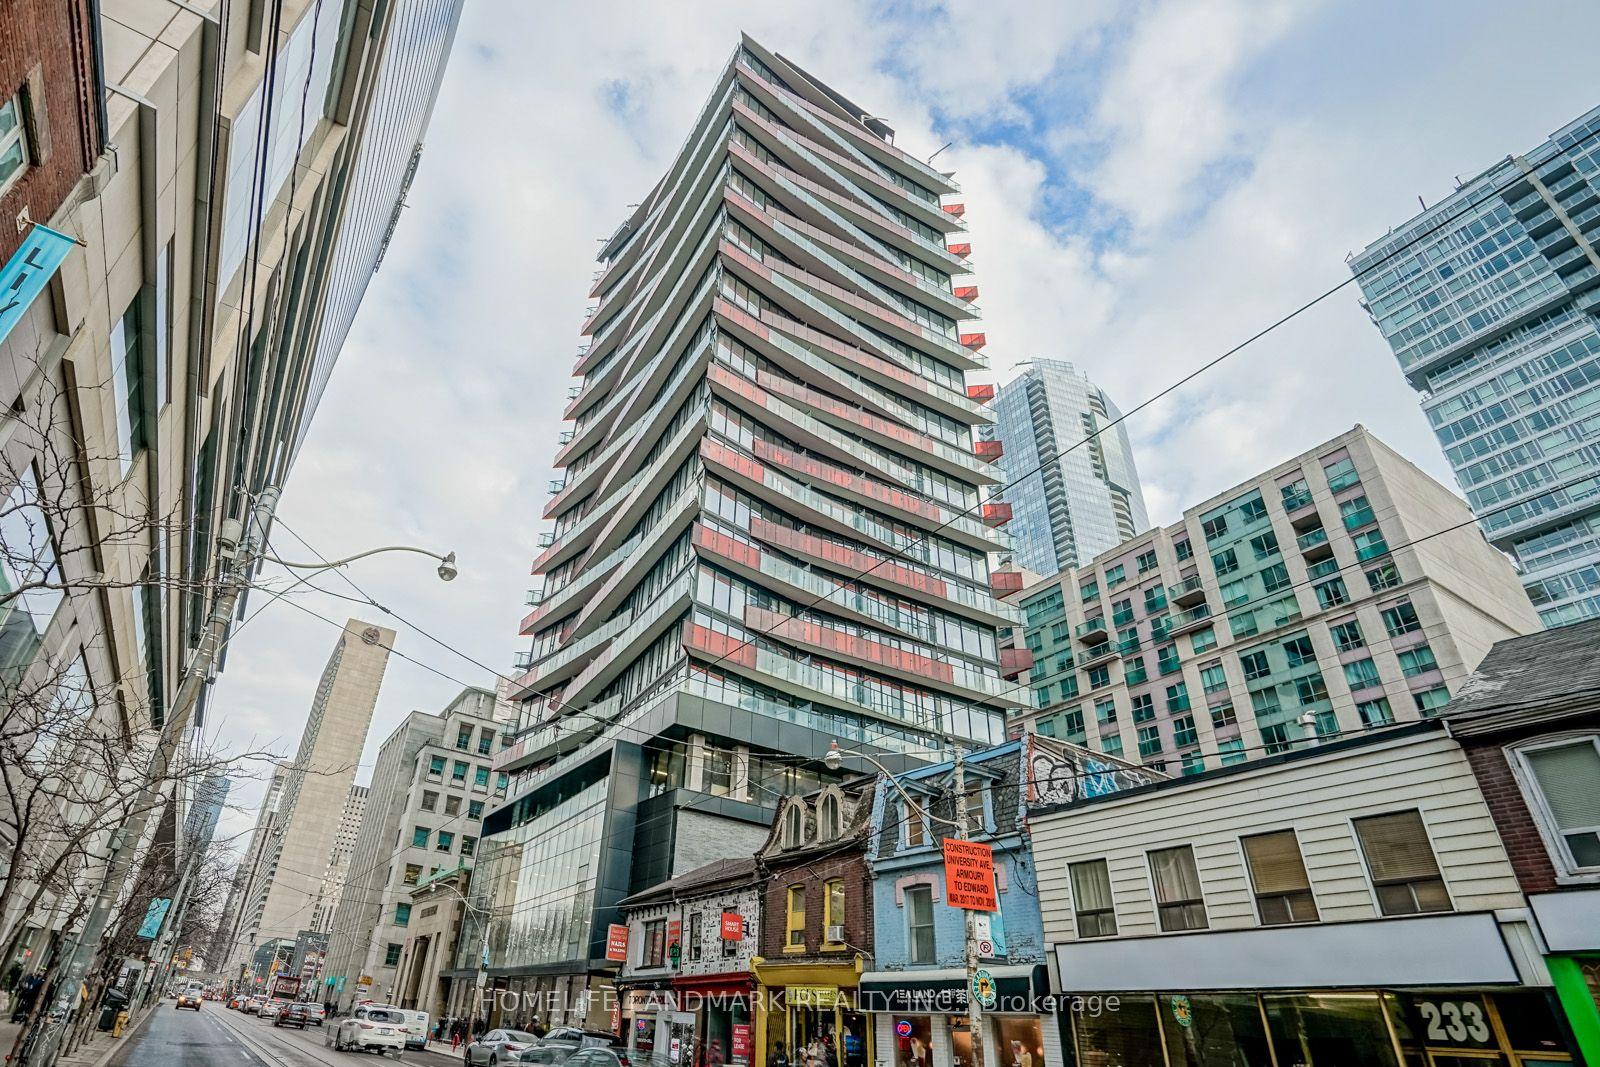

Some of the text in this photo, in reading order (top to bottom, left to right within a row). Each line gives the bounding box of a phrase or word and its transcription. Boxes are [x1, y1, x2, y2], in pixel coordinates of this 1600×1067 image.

[945, 843, 991, 857] CONSTRUCTION
[946, 855, 991, 870] UNIVERSITY AVE.
[956, 869, 985, 880] ARMOURY
[954, 881, 989, 894] TO EDWARD
[970, 896, 975, 905] TO
[913, 988, 936, 998] LAND
[1421, 1002, 1490, 1043] 233
